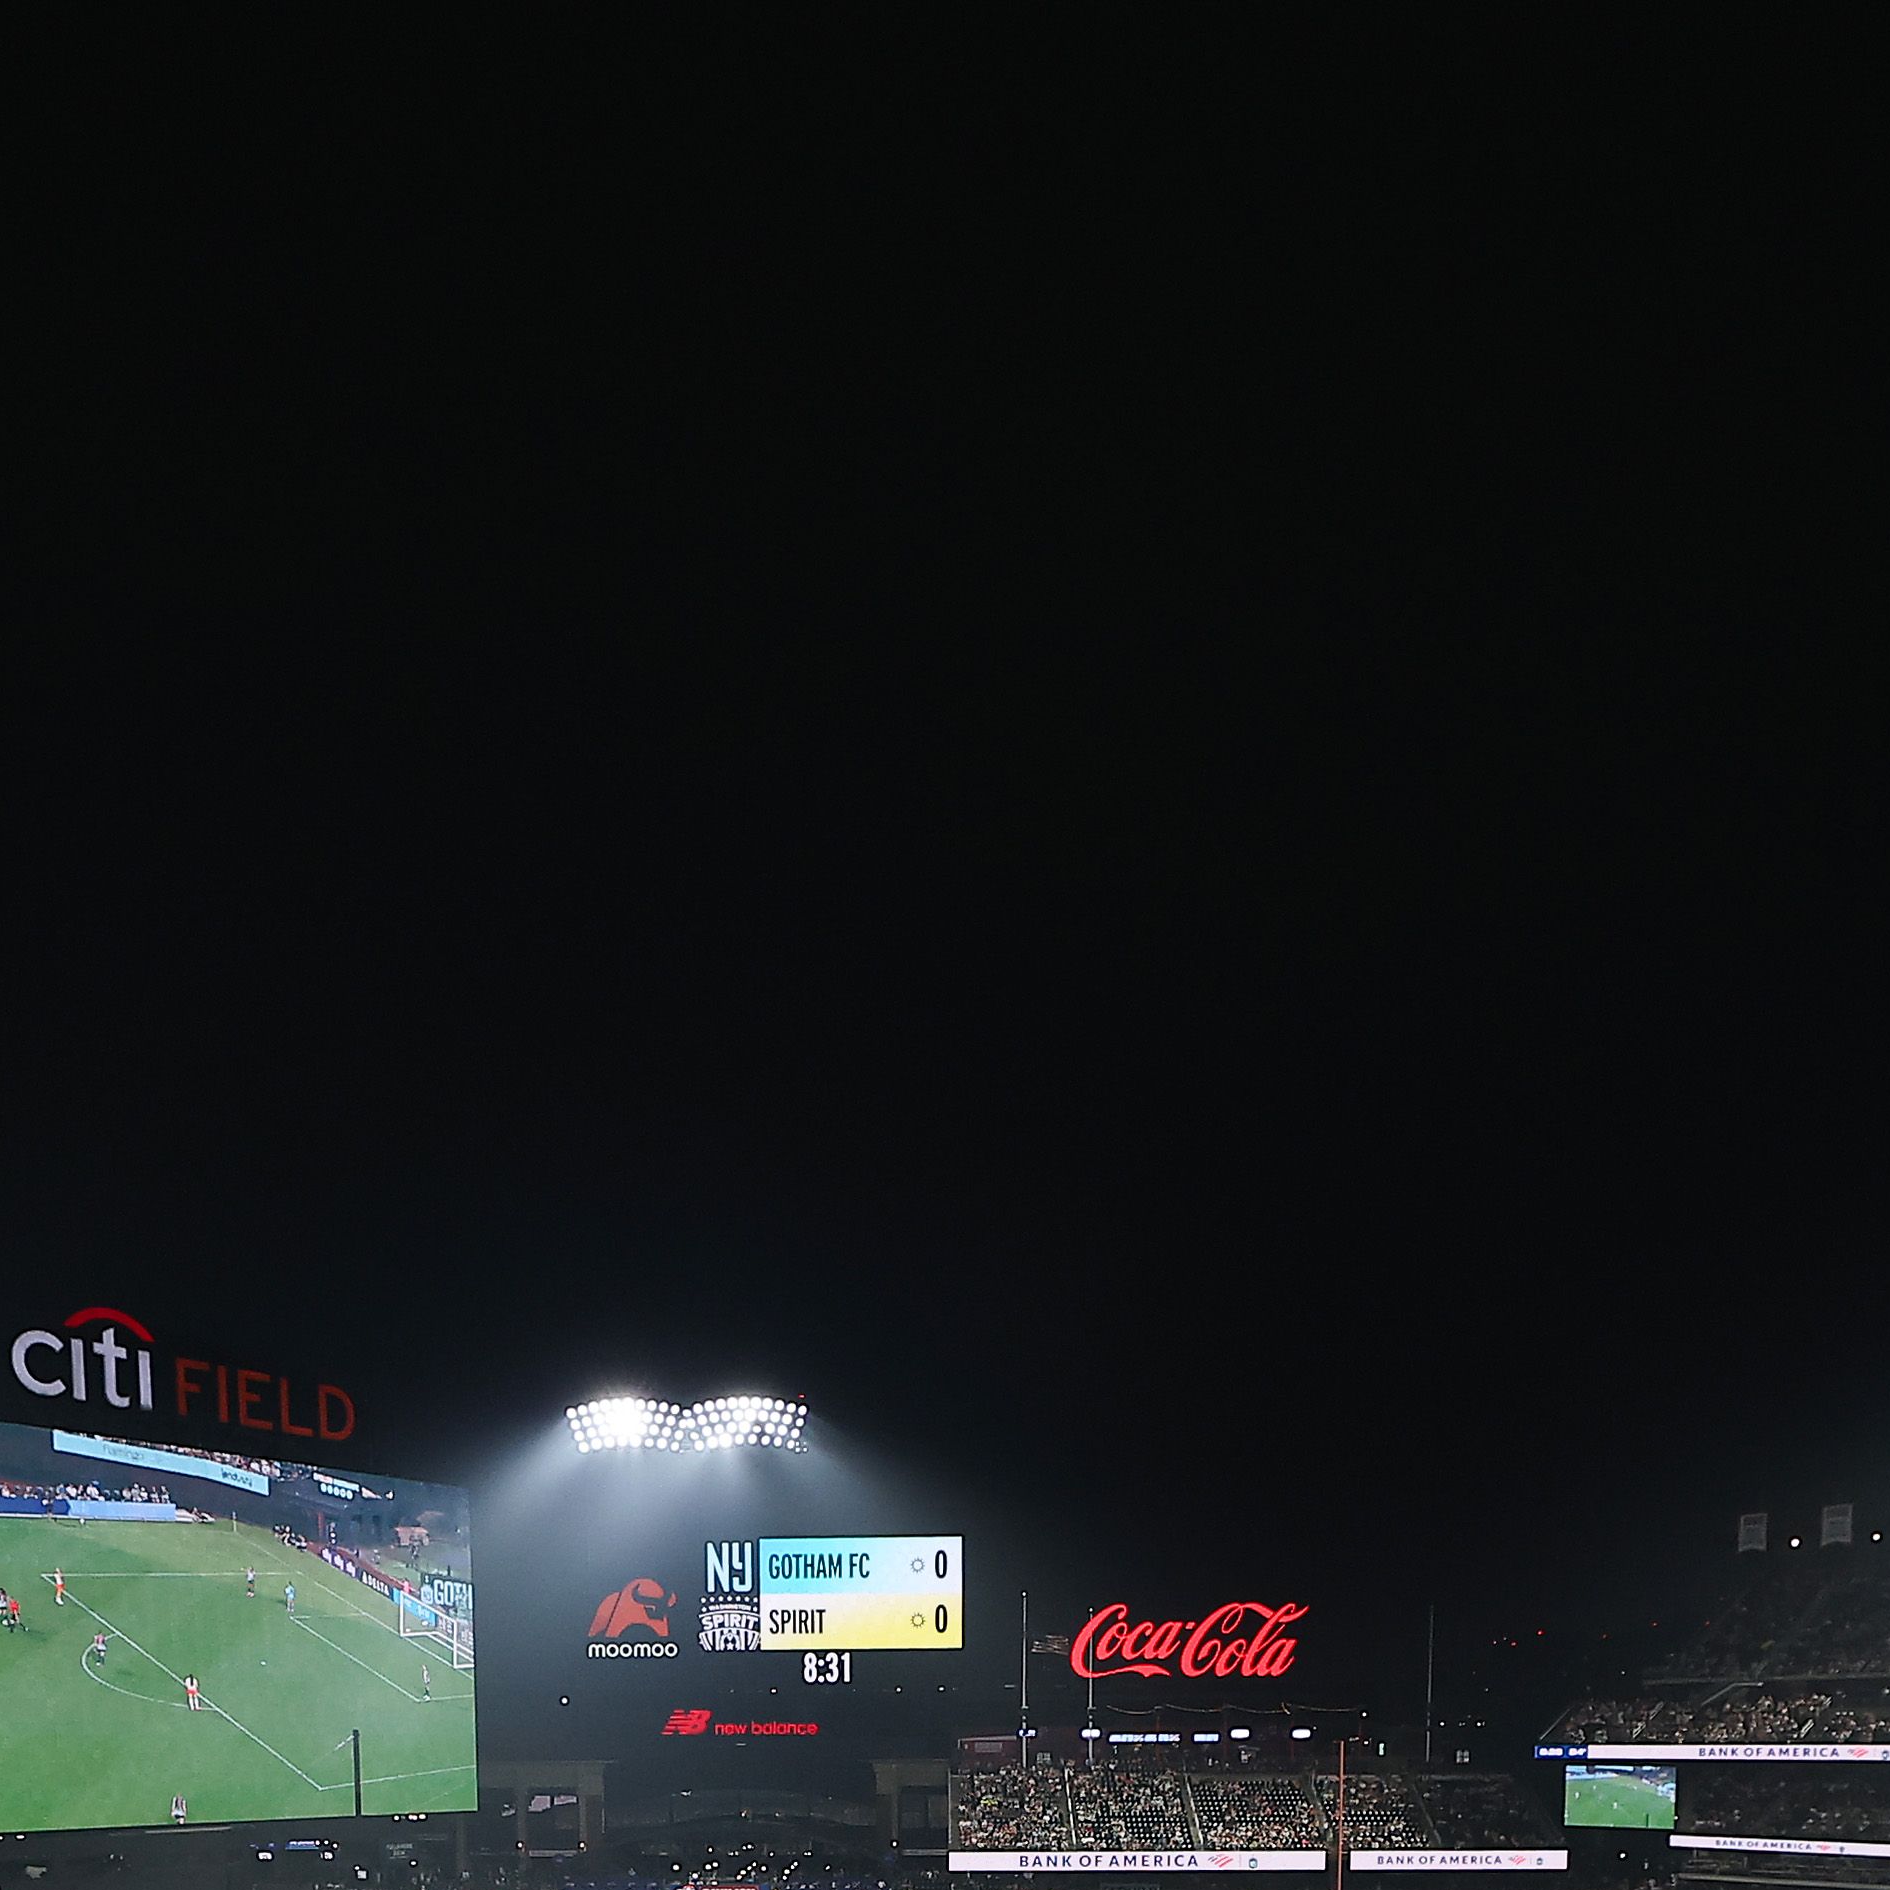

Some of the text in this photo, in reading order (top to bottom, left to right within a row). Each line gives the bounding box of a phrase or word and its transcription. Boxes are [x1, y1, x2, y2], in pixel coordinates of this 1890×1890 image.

[11, 1318, 356, 1440] citi FIELD
[705, 1541, 753, 1593] NY
[767, 1550, 948, 1580] GOTHAM FC 0
[701, 1613, 759, 1630] SPIRIT
[768, 1604, 948, 1635] SPIRIT 0
[587, 1642, 679, 1659] moomoo
[1069, 1602, 1310, 1679] Coca-Cola
[802, 1651, 852, 1683] 8:31
[714, 1720, 820, 1736] new balance
[1698, 1747, 1840, 1758] BANK OF AMERICA
[1019, 1855, 1199, 1868] BANK OF AMERICA
[1377, 1855, 1503, 1866] BANK OF AMERICA
